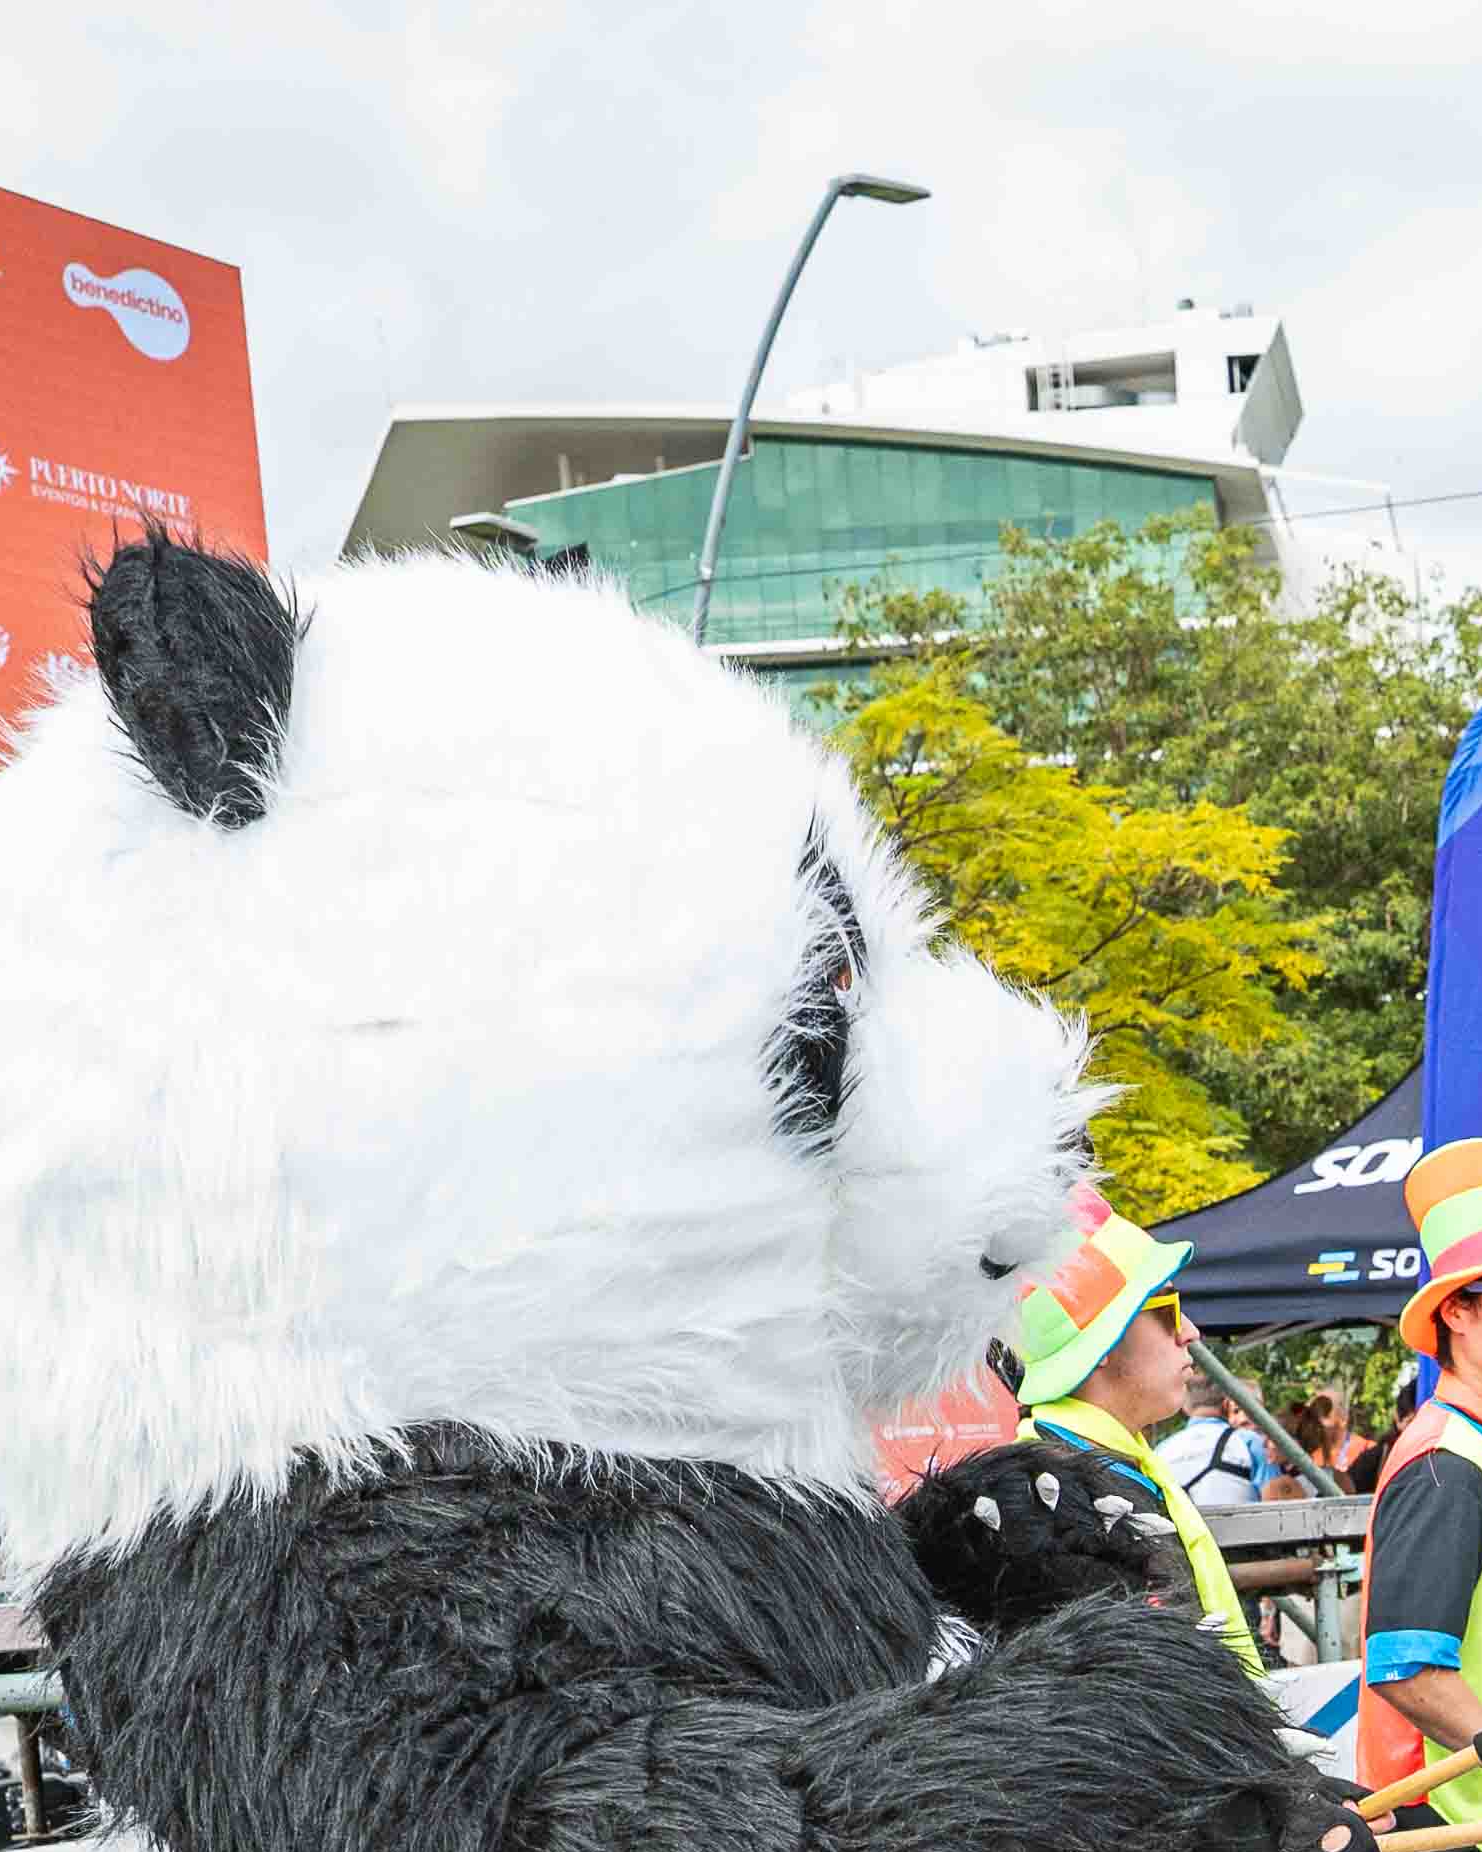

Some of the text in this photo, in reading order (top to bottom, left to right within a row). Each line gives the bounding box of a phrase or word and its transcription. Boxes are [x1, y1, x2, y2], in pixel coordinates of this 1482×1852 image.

[70, 272, 184, 324] benedictino
[30, 456, 191, 516] PUERTO NORTE
